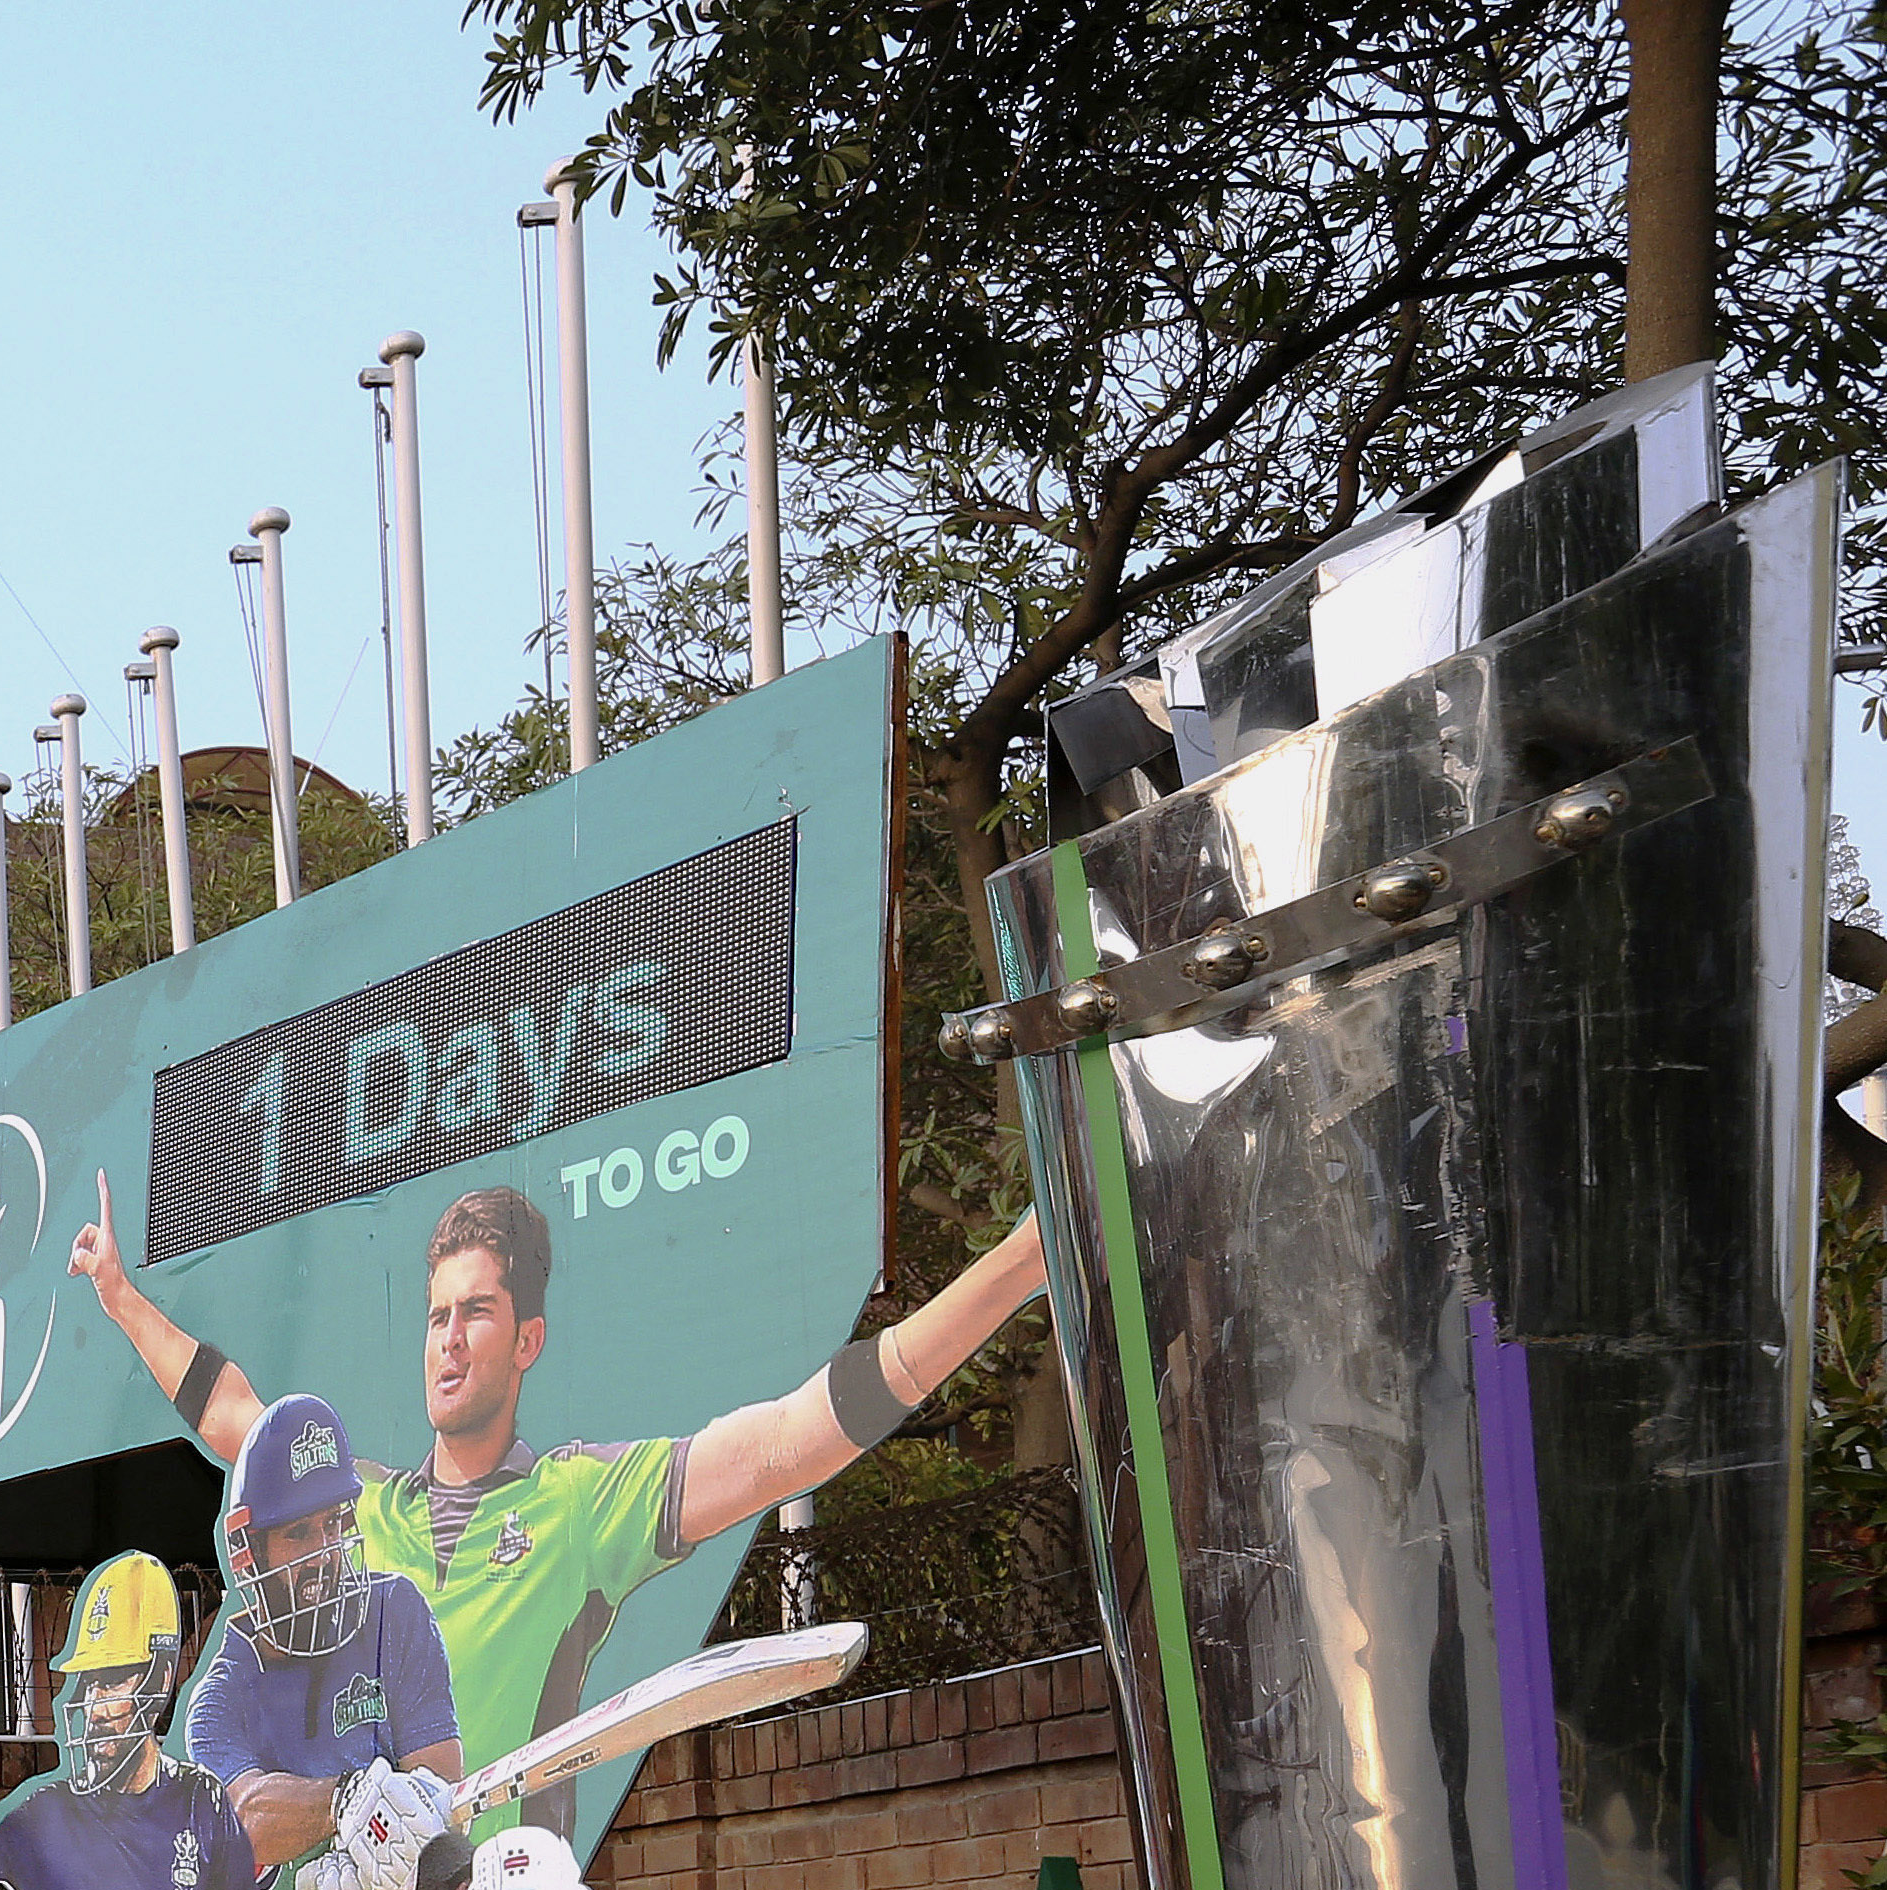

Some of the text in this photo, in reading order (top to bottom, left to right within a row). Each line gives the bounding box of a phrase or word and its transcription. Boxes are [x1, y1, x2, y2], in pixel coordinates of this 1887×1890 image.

[240, 959, 668, 1196] 1 Days
[561, 1114, 750, 1221] TO GO
